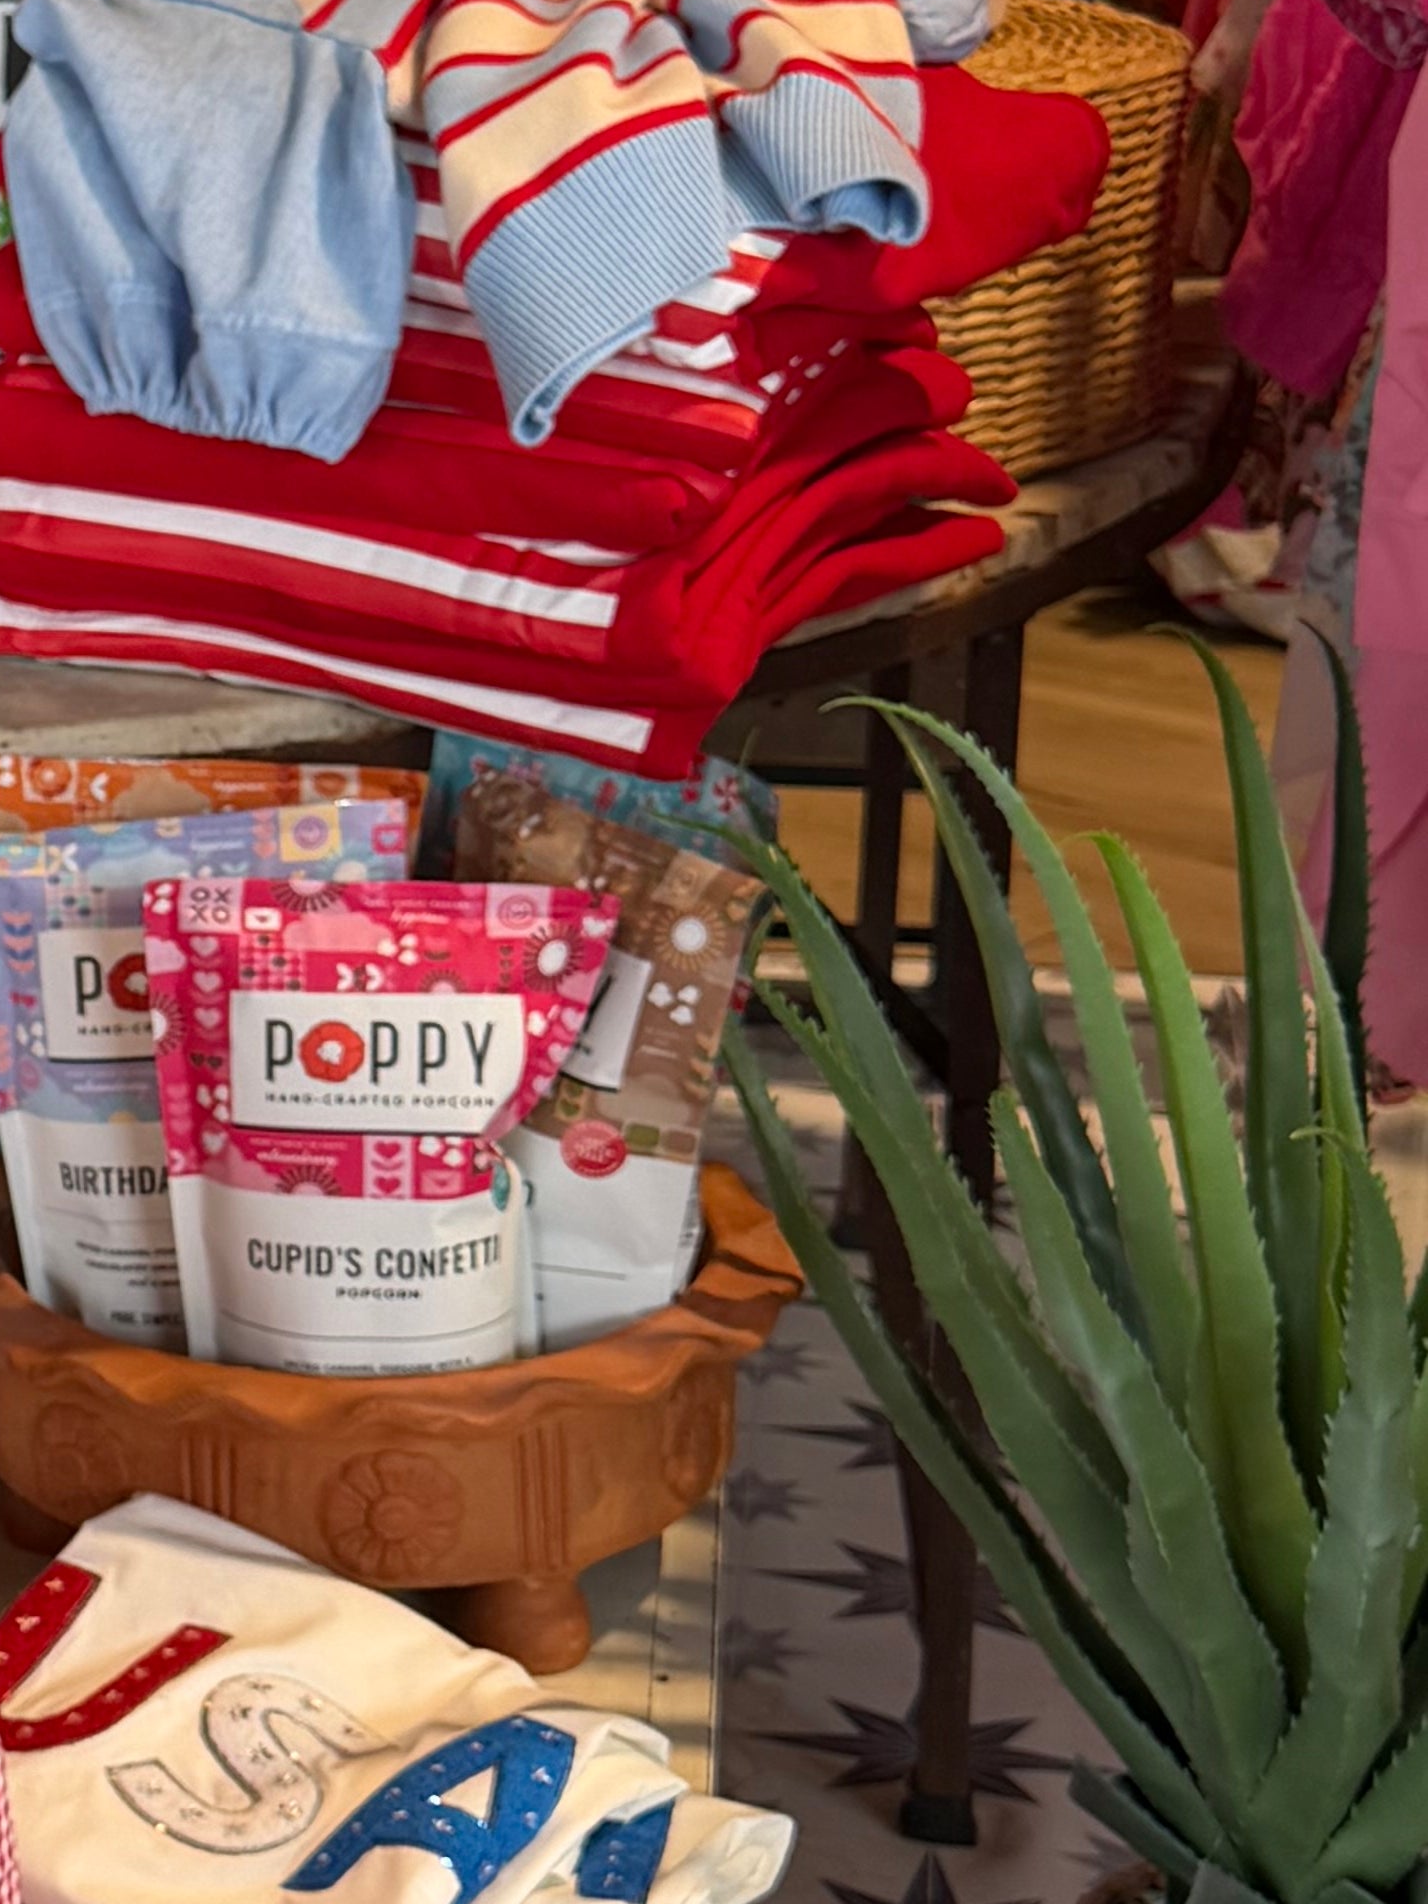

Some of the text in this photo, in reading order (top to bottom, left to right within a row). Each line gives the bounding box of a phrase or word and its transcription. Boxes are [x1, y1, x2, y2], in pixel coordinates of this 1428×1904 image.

[264, 1018, 495, 1085] POPPY
[264, 1092, 496, 1108] HAND-CRAFTED POPCORN
[248, 1233, 502, 1279] CUPID'S CONFETTI
[335, 1286, 420, 1299] POPCORN
